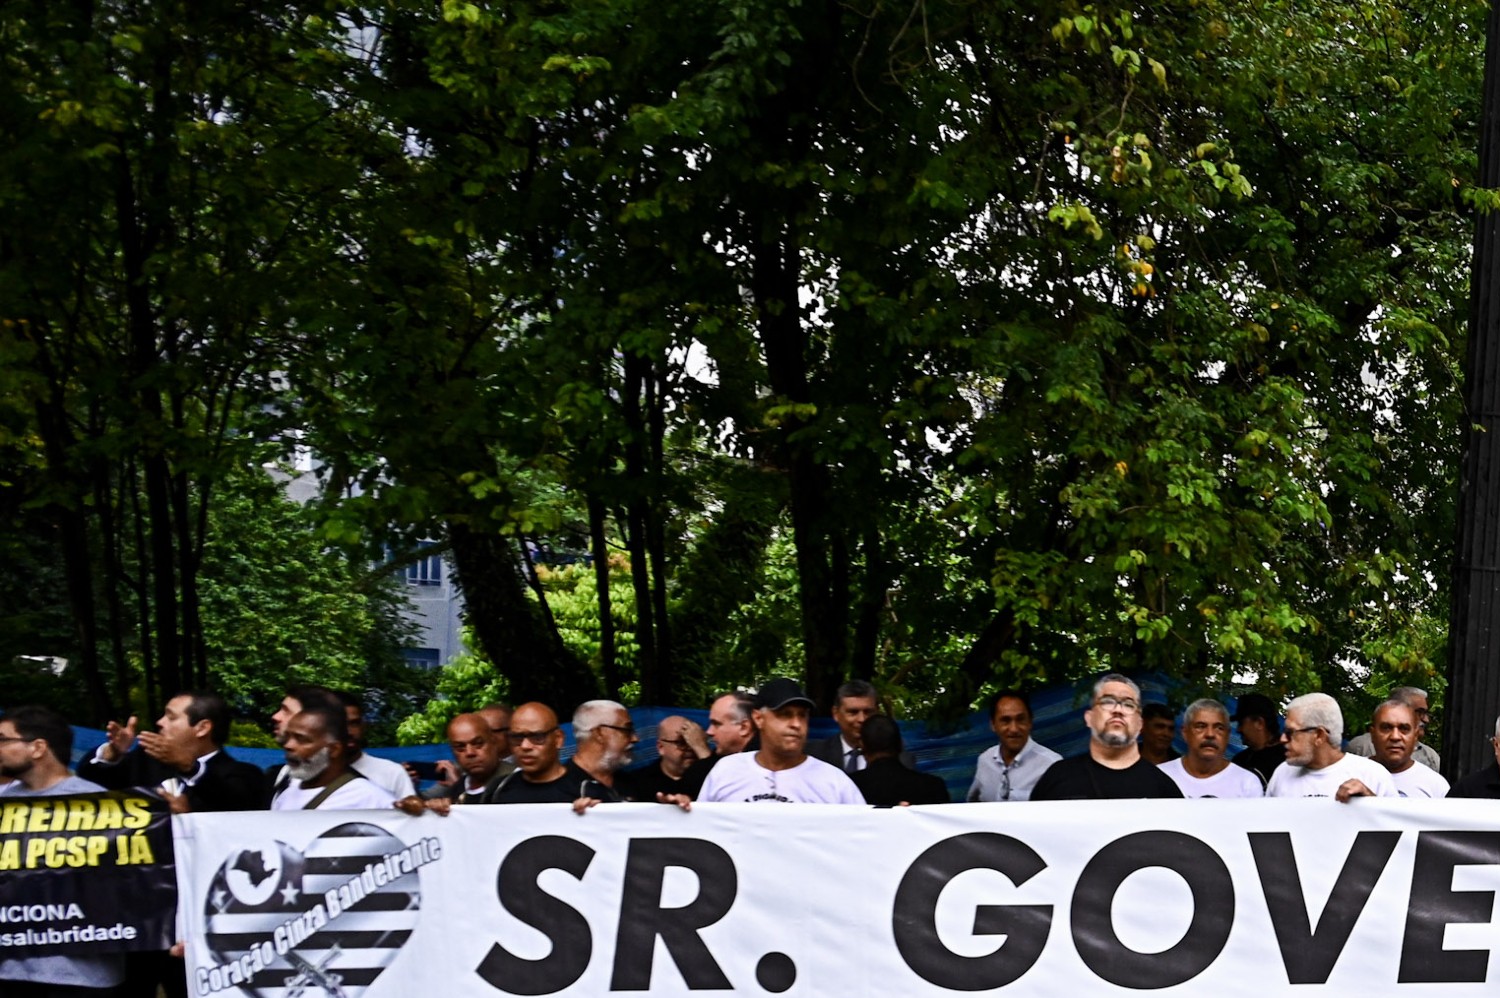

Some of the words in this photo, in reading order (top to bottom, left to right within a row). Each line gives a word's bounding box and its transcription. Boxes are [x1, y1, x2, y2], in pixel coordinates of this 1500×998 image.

[0, 798, 152, 834] REIRAS
[0, 839, 21, 871] A
[25, 835, 109, 869] PCSP
[115, 830, 155, 866] JÁ
[195, 940, 275, 996] Coração
[273, 903, 328, 956] Cinza
[324, 837, 443, 919] Bandeirante
[476, 834, 797, 996] SR.
